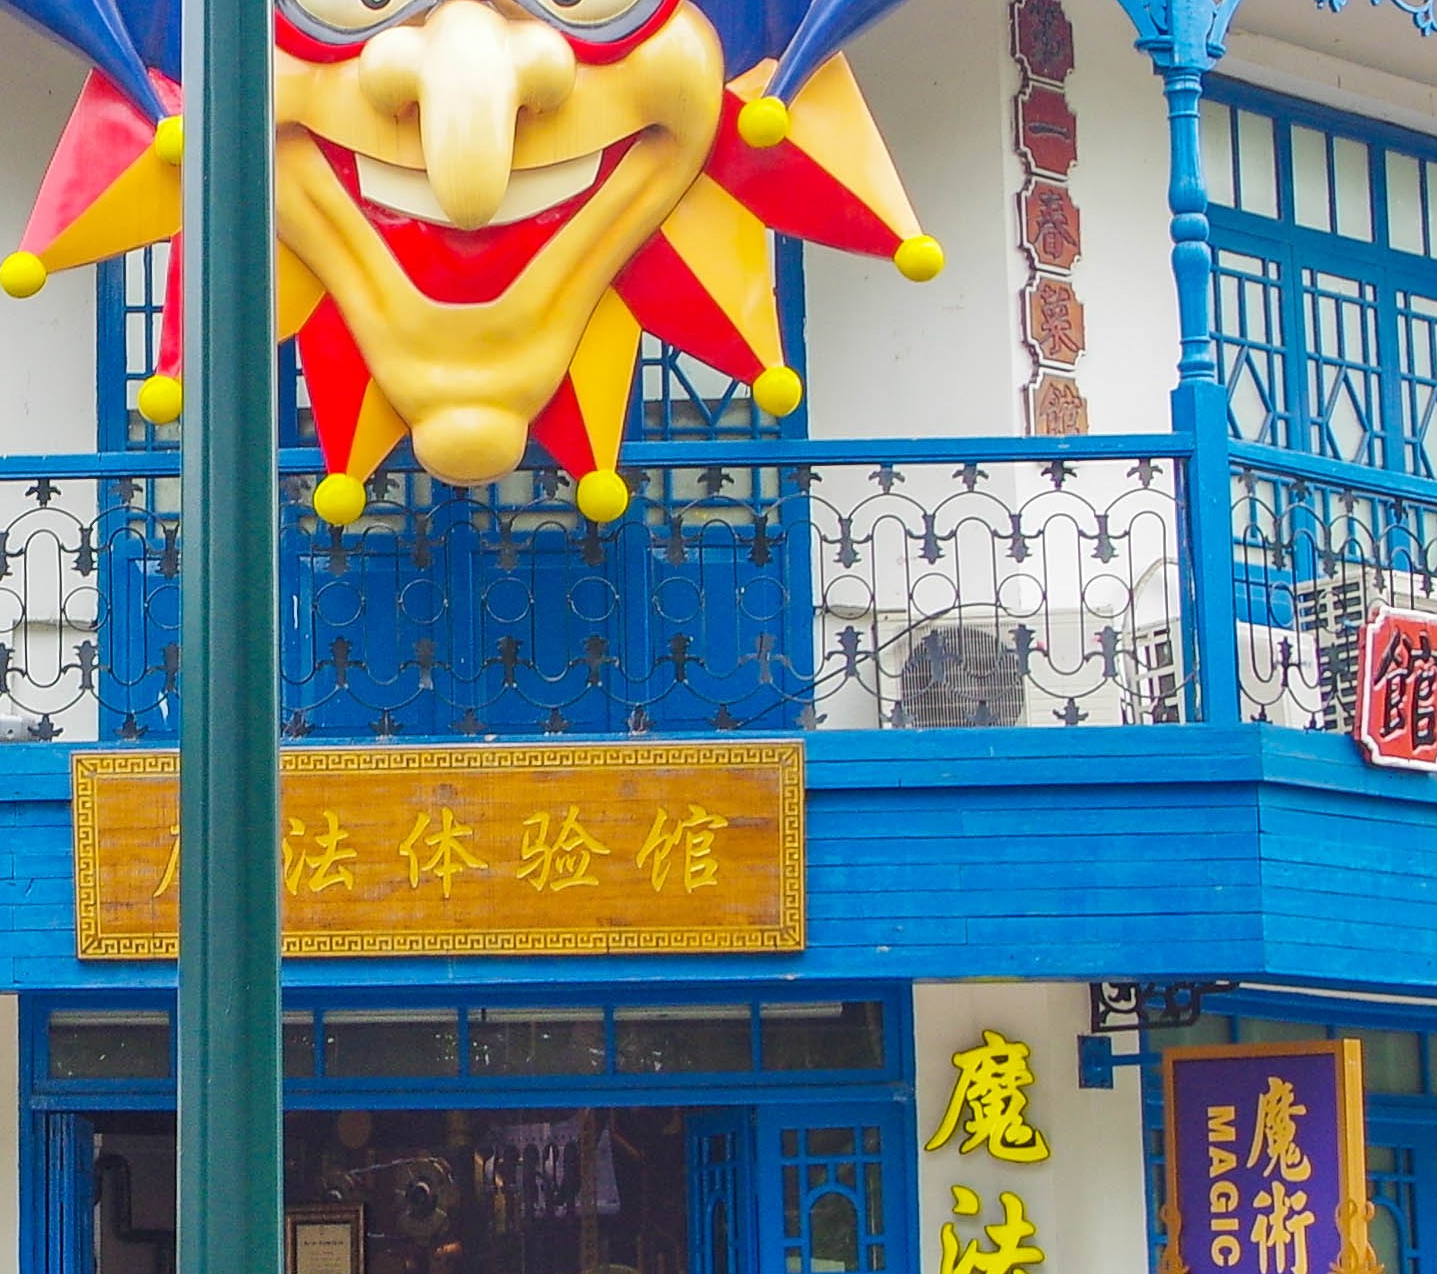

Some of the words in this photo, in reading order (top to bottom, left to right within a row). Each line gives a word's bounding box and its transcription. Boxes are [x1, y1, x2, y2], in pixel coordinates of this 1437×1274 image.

[152, 804, 728, 899] 法体验馆
[1206, 1104, 1241, 1268] MAGIC
